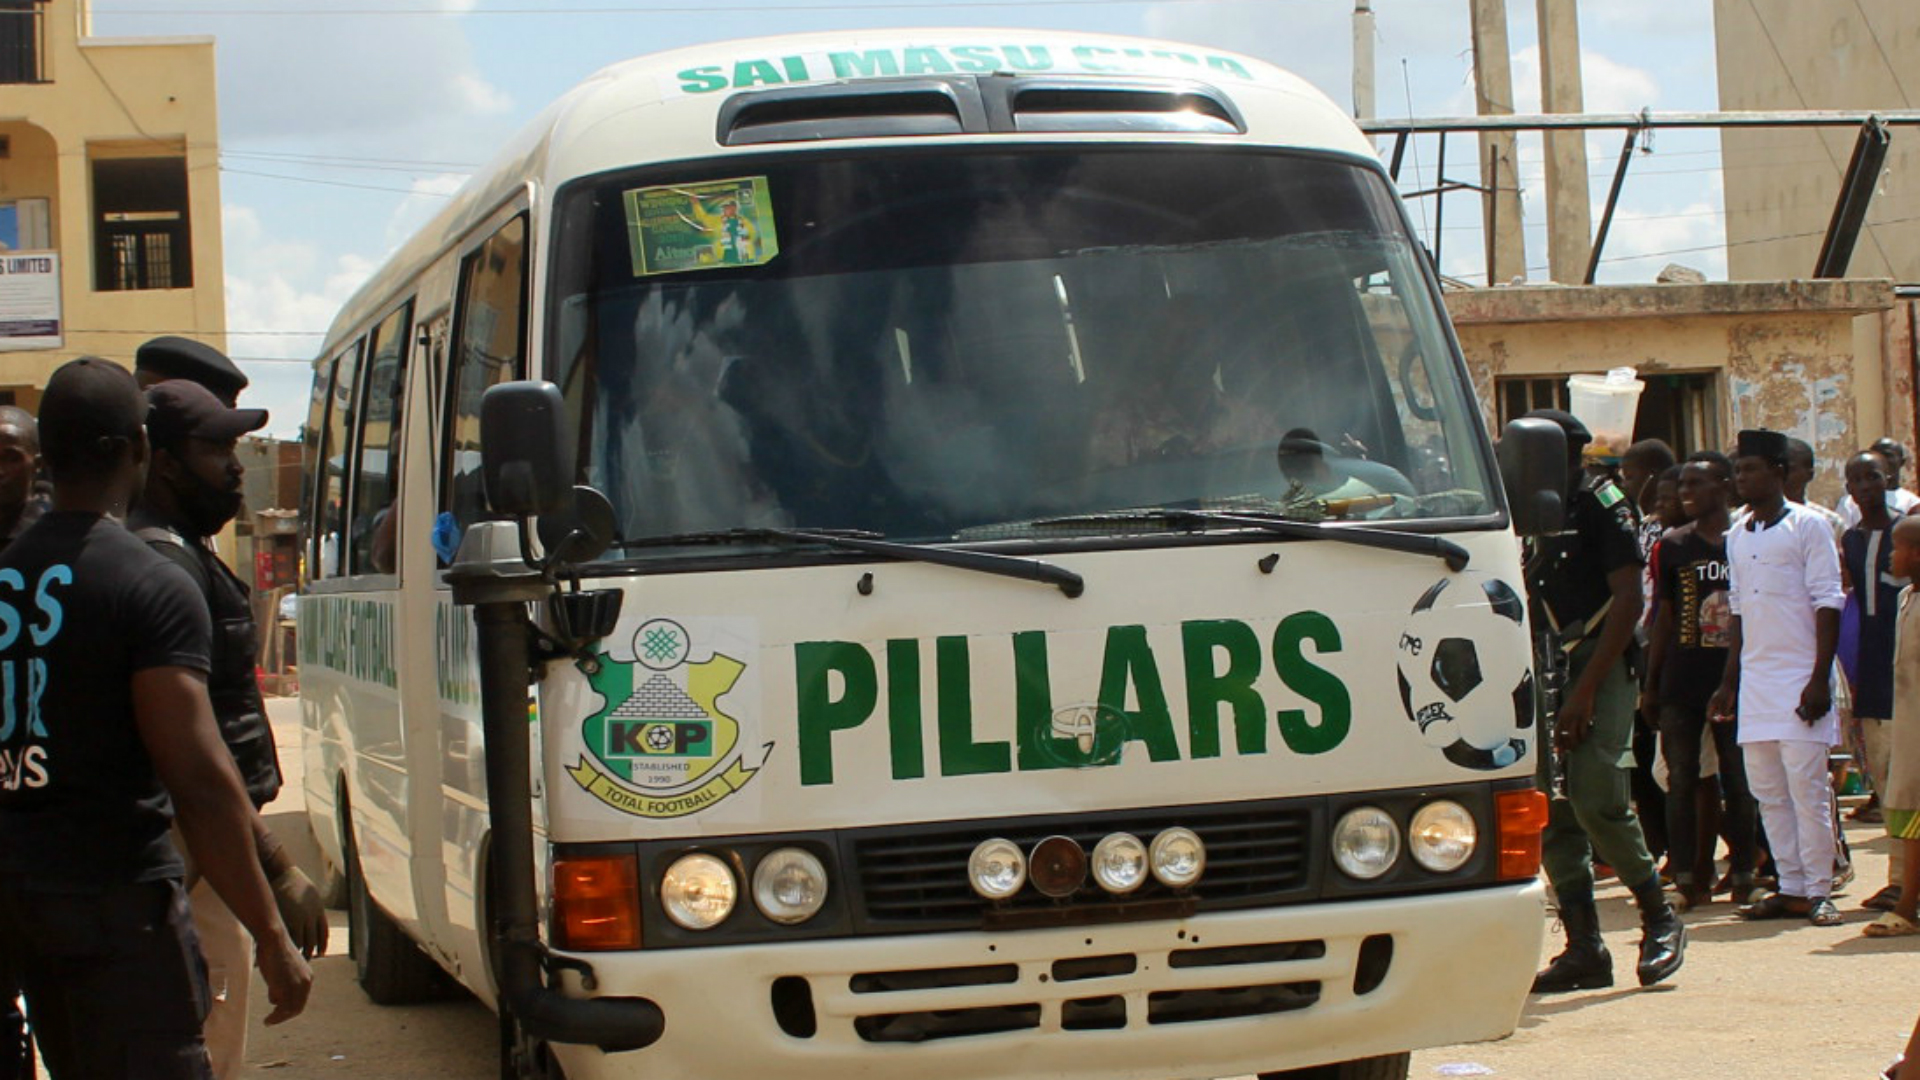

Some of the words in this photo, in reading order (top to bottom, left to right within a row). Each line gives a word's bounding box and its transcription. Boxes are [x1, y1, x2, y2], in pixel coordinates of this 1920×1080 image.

[677, 55, 809, 93] SAI
[828, 45, 1054, 78] MASU
[8, 258, 51, 273] LIMITED
[794, 610, 1352, 786] PILLARS
[629, 762, 690, 771] ESTABLISHED
[648, 775, 671, 784] 1990
[604, 785, 644, 811] TOTAL
[647, 788, 718, 813] FOOTBALL
